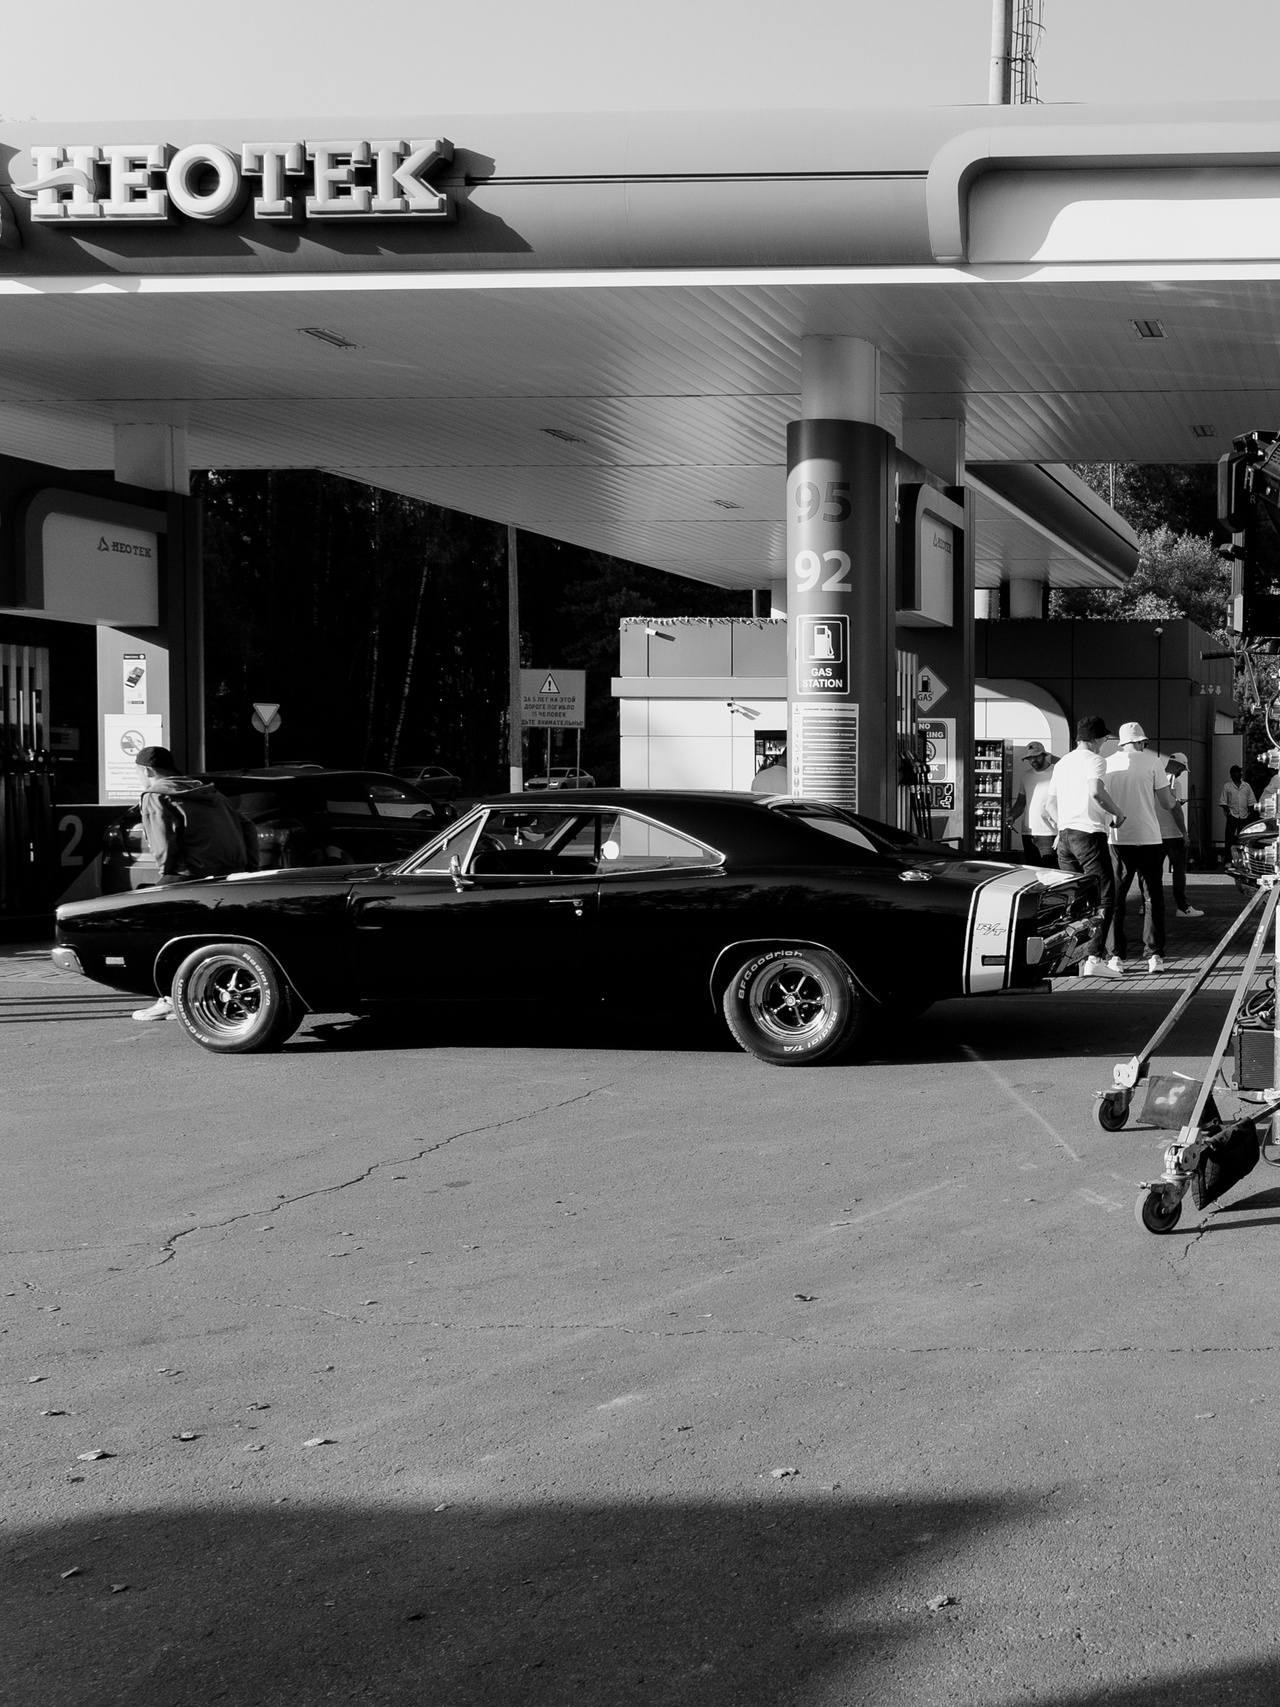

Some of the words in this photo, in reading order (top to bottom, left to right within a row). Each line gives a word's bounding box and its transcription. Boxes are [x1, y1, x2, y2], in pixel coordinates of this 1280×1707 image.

[795, 482, 851, 523] 95
[795, 550, 852, 592] 92
[802, 679, 843, 688] STATION
[811, 668, 833, 677] GAS
[917, 693, 933, 702] GAS
[58, 815, 84, 866] 2
[738, 950, 803, 999] BFGoodrich
